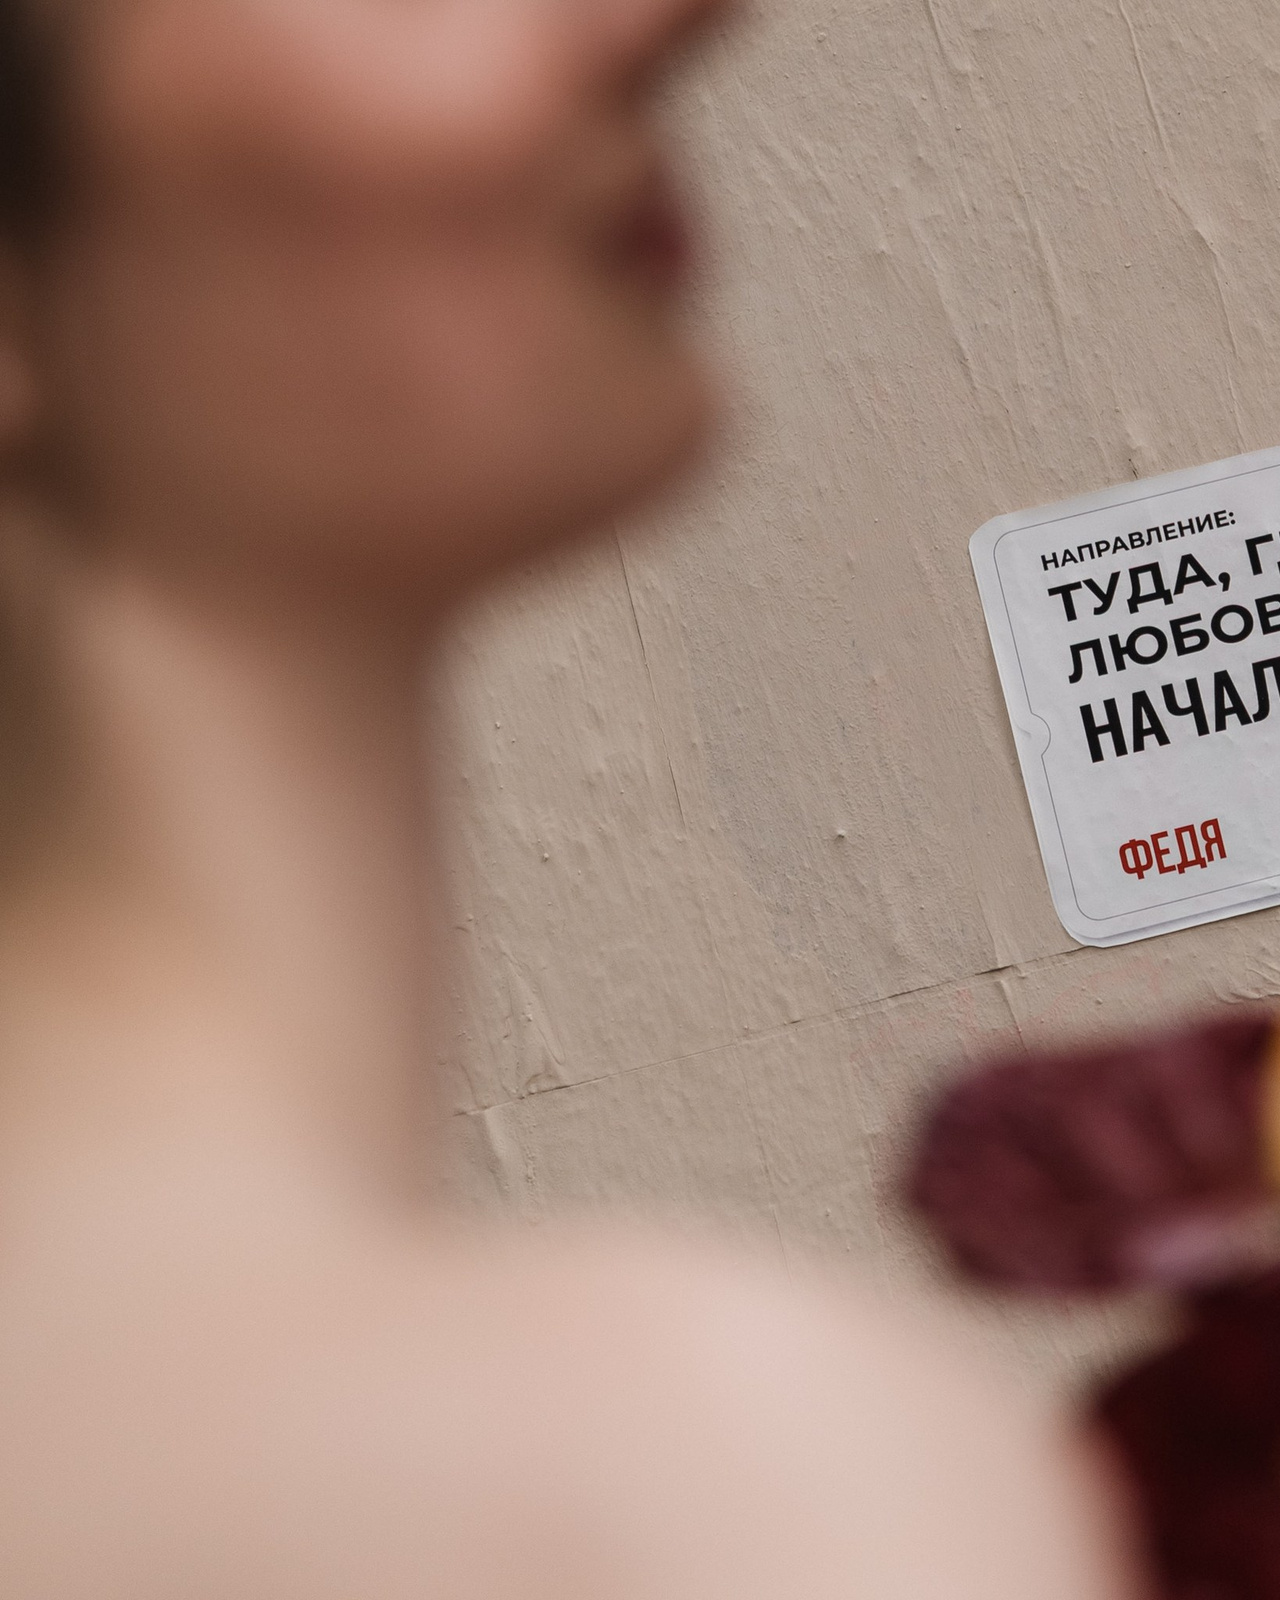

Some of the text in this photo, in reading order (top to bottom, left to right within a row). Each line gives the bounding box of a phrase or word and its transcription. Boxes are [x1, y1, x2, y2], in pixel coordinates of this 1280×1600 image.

[1041, 509, 1236, 571] НАПРАВЛЕНИЕ:
[1048, 553, 1231, 622] ТУДА,
[1118, 817, 1228, 881] ФЕДЯ
